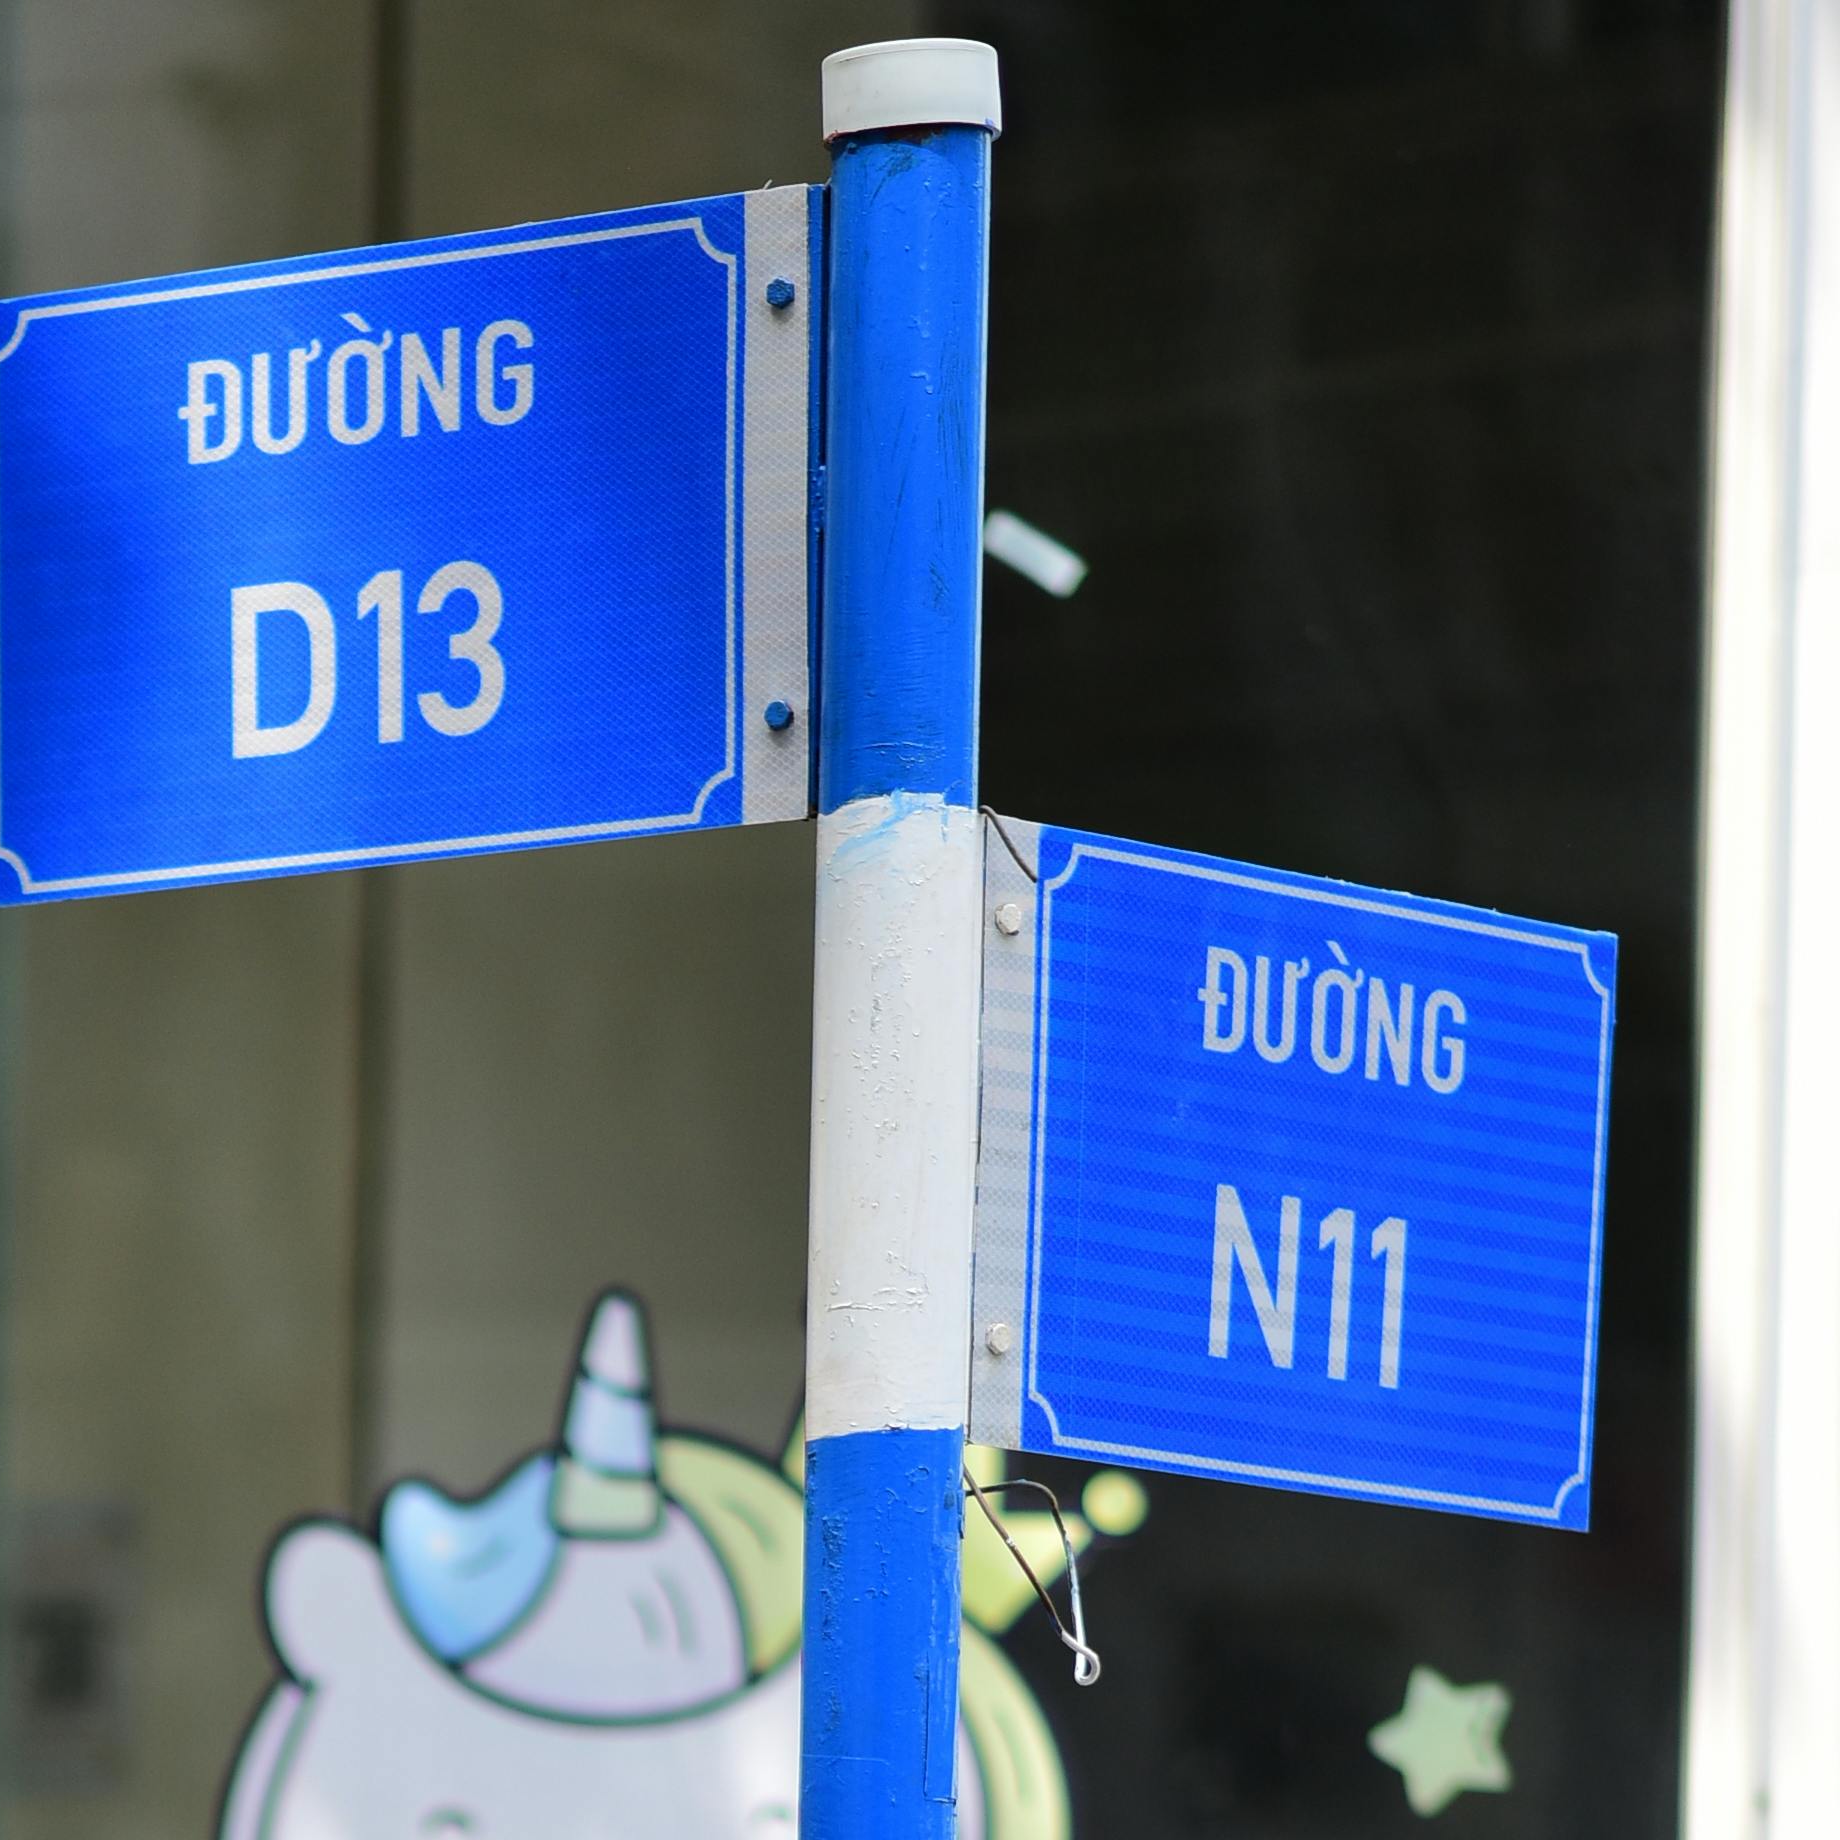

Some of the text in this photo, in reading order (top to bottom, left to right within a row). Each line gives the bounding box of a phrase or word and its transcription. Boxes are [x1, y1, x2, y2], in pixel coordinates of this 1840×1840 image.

[178, 312, 535, 465] ĐƯỜNG
[230, 560, 506, 760] D13
[1197, 939, 1468, 1095] ĐƯỜNG
[1208, 1183, 1407, 1389] N11
